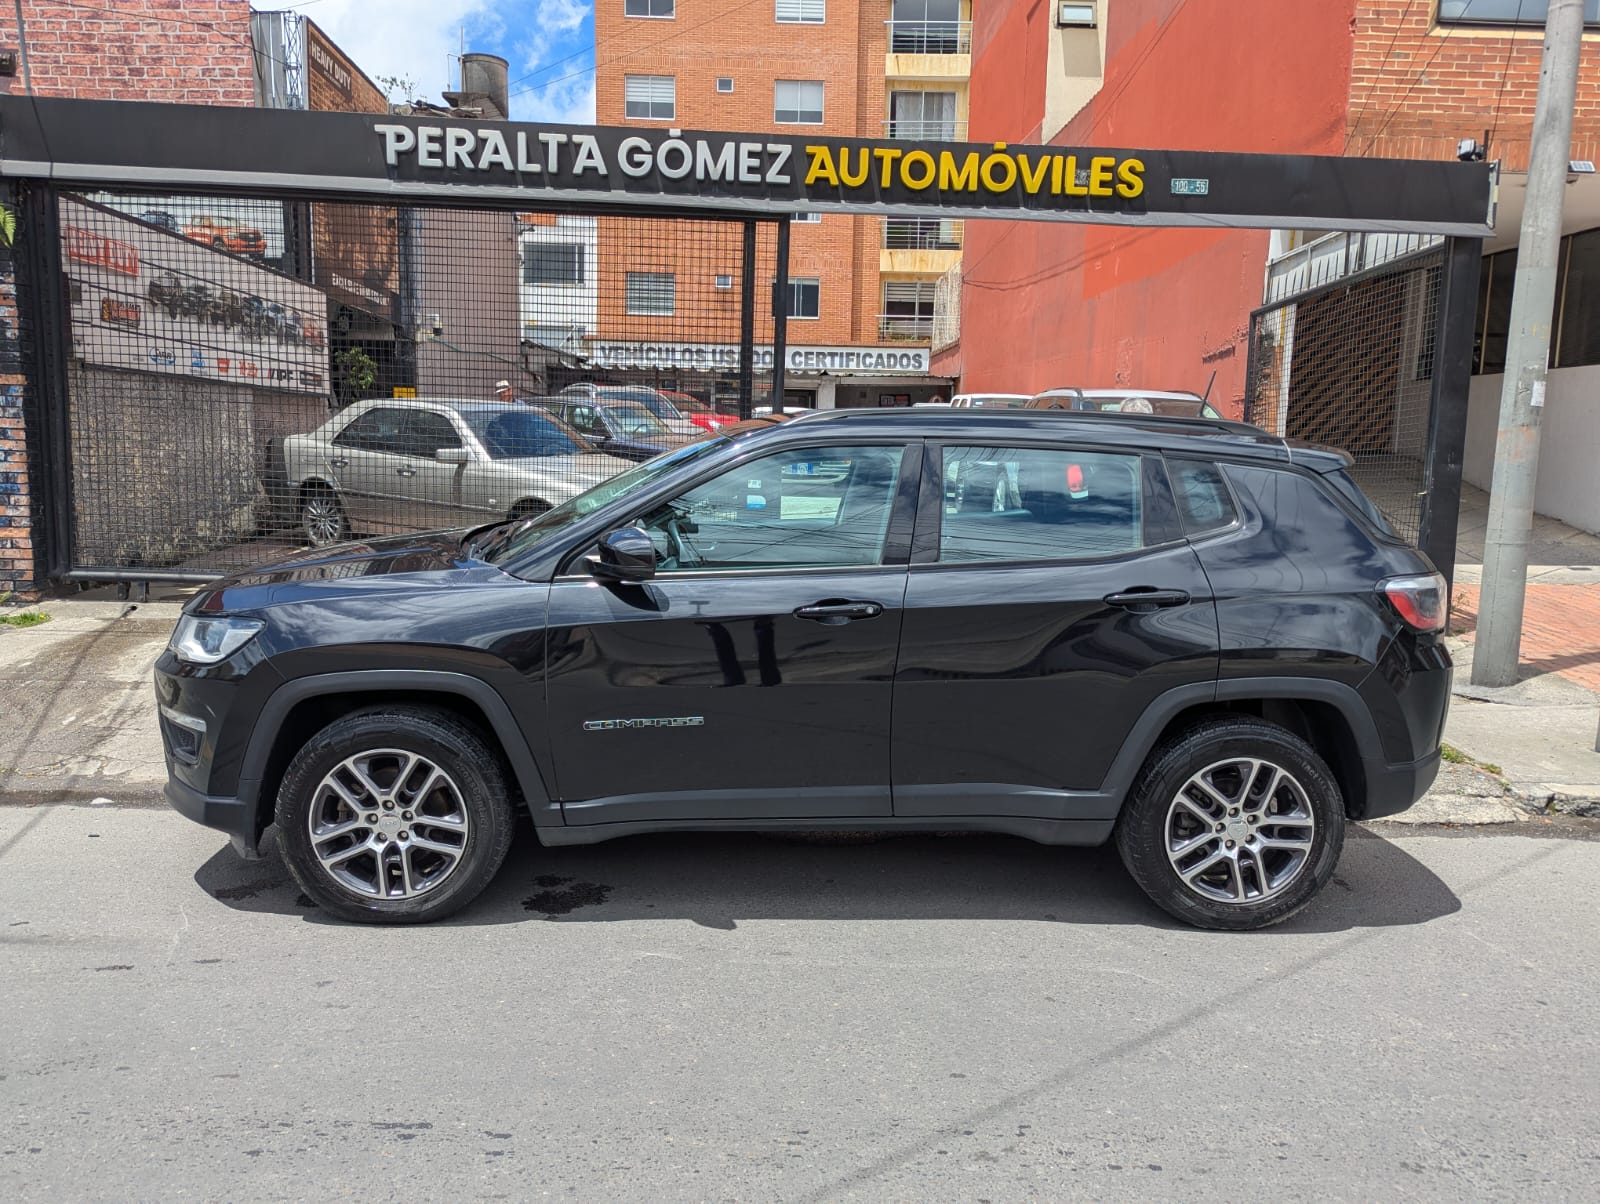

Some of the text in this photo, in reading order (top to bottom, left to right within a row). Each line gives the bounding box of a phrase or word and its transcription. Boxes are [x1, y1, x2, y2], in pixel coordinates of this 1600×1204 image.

[311, 40, 334, 74] HEAVY
[334, 62, 351, 91] DUTY
[374, 123, 1146, 199] PERALTA GÓMEZ AUTOMÓVILES
[1174, 180, 1188, 193] 100
[599, 342, 707, 366] VEHÍCULOS
[790, 350, 924, 370] CERTIFICADOS
[582, 716, 704, 730] COMPASS
